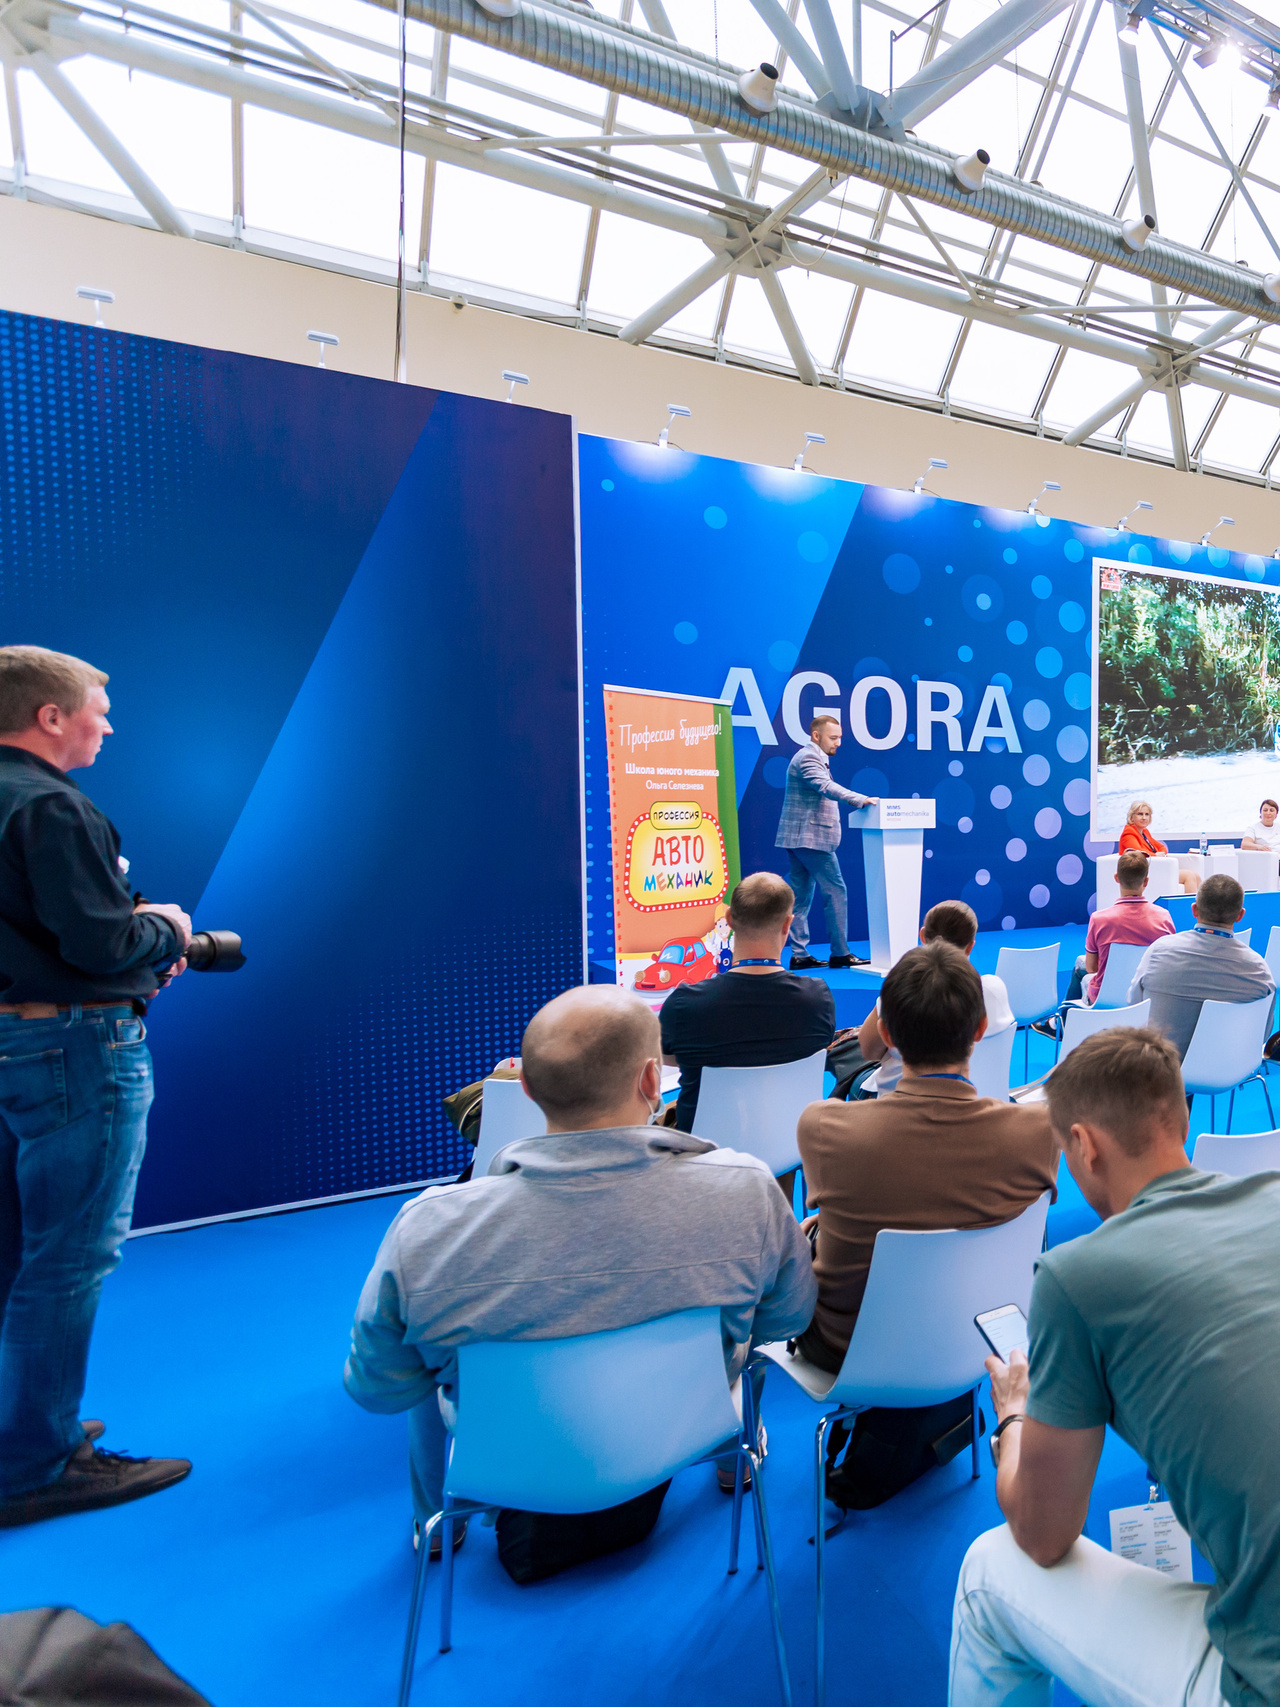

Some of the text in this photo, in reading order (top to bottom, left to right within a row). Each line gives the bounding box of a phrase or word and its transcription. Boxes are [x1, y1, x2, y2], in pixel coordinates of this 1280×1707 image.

[720, 667, 1023, 753] AGORA
[619, 713, 722, 753] Профессия будущего!
[625, 763, 719, 777] Школа юного механика
[645, 780, 704, 790] Ольга Селезнева
[653, 811, 699, 820] ПРОФЕССИЯ
[652, 835, 704, 866] АВТО
[643, 870, 713, 891] МЕХАНИК
